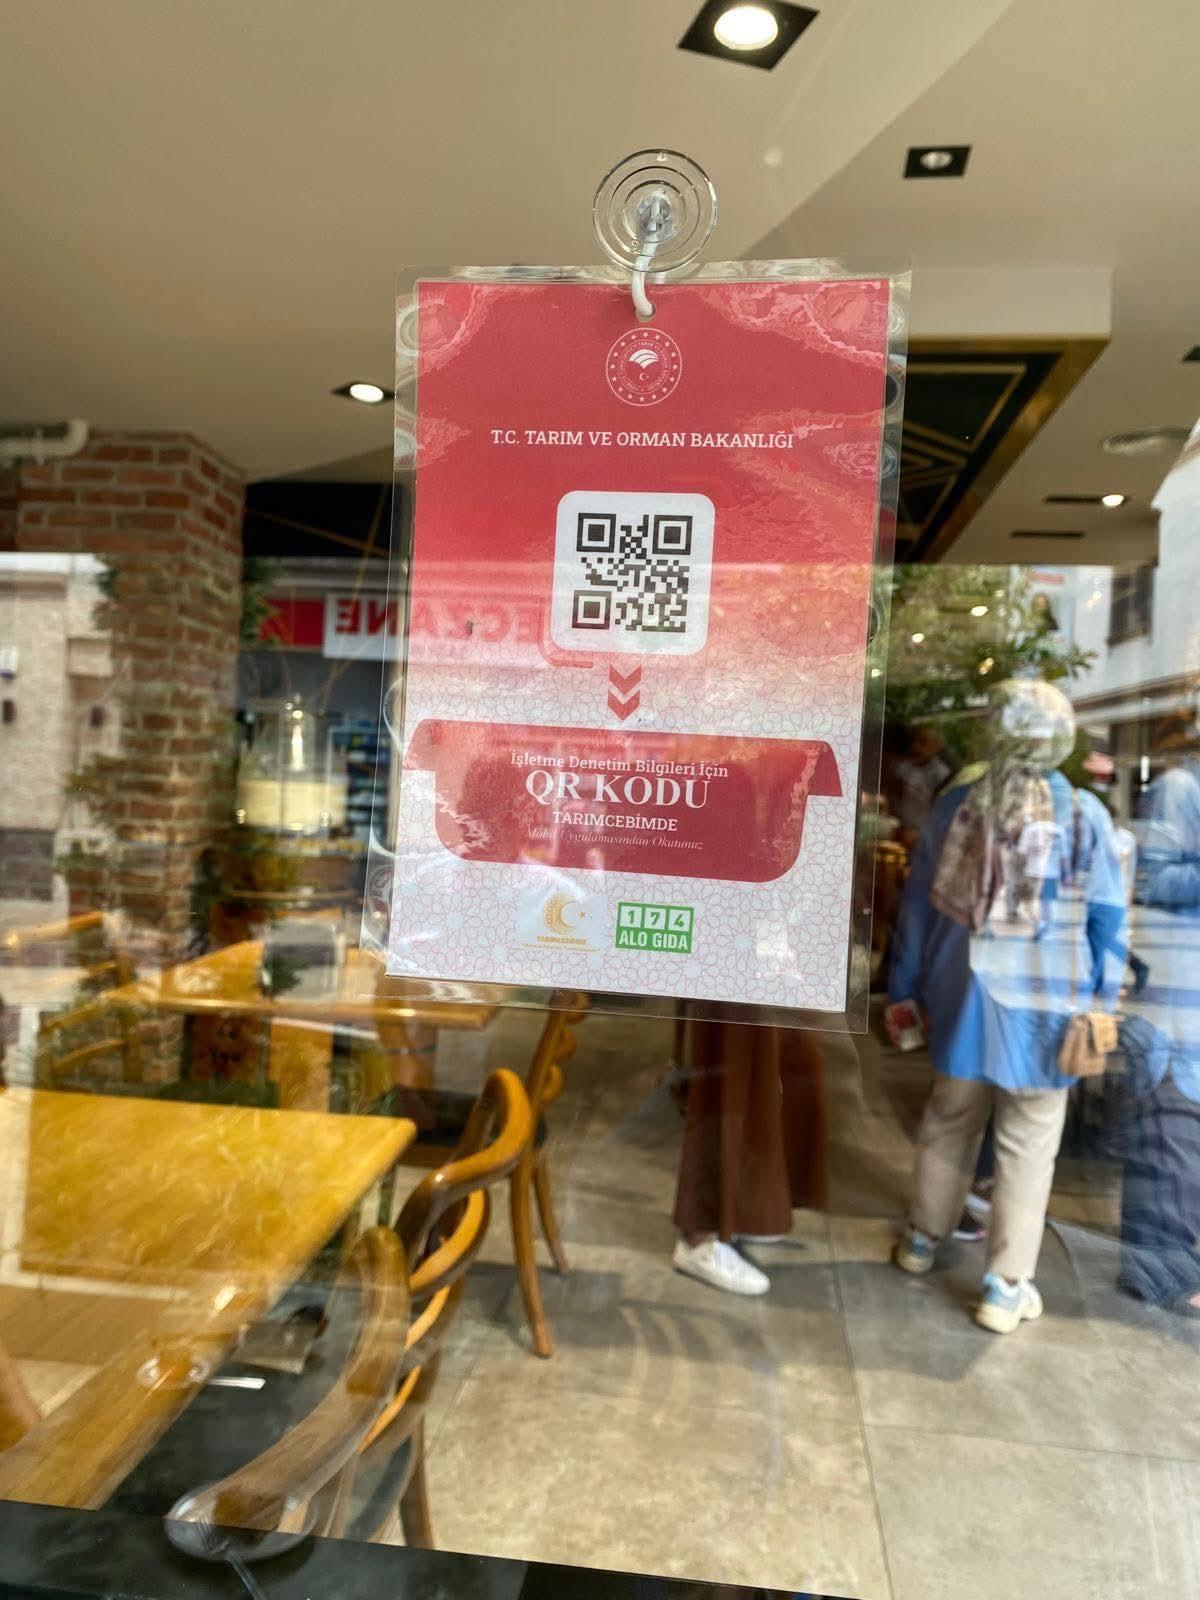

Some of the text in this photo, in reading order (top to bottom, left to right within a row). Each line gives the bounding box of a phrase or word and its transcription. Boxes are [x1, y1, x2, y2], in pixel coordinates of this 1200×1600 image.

[491, 429, 794, 449] T.C. TARIM VE ORMAN BAKANLIĞI
[511, 752, 729, 779] İşletme Denetim Bilgileri İçin
[526, 769, 711, 809] QR KODU
[552, 810, 678, 832] TARIMCEBİMDE
[618, 929, 648, 948] ALO
[652, 932, 689, 951] GIDA
